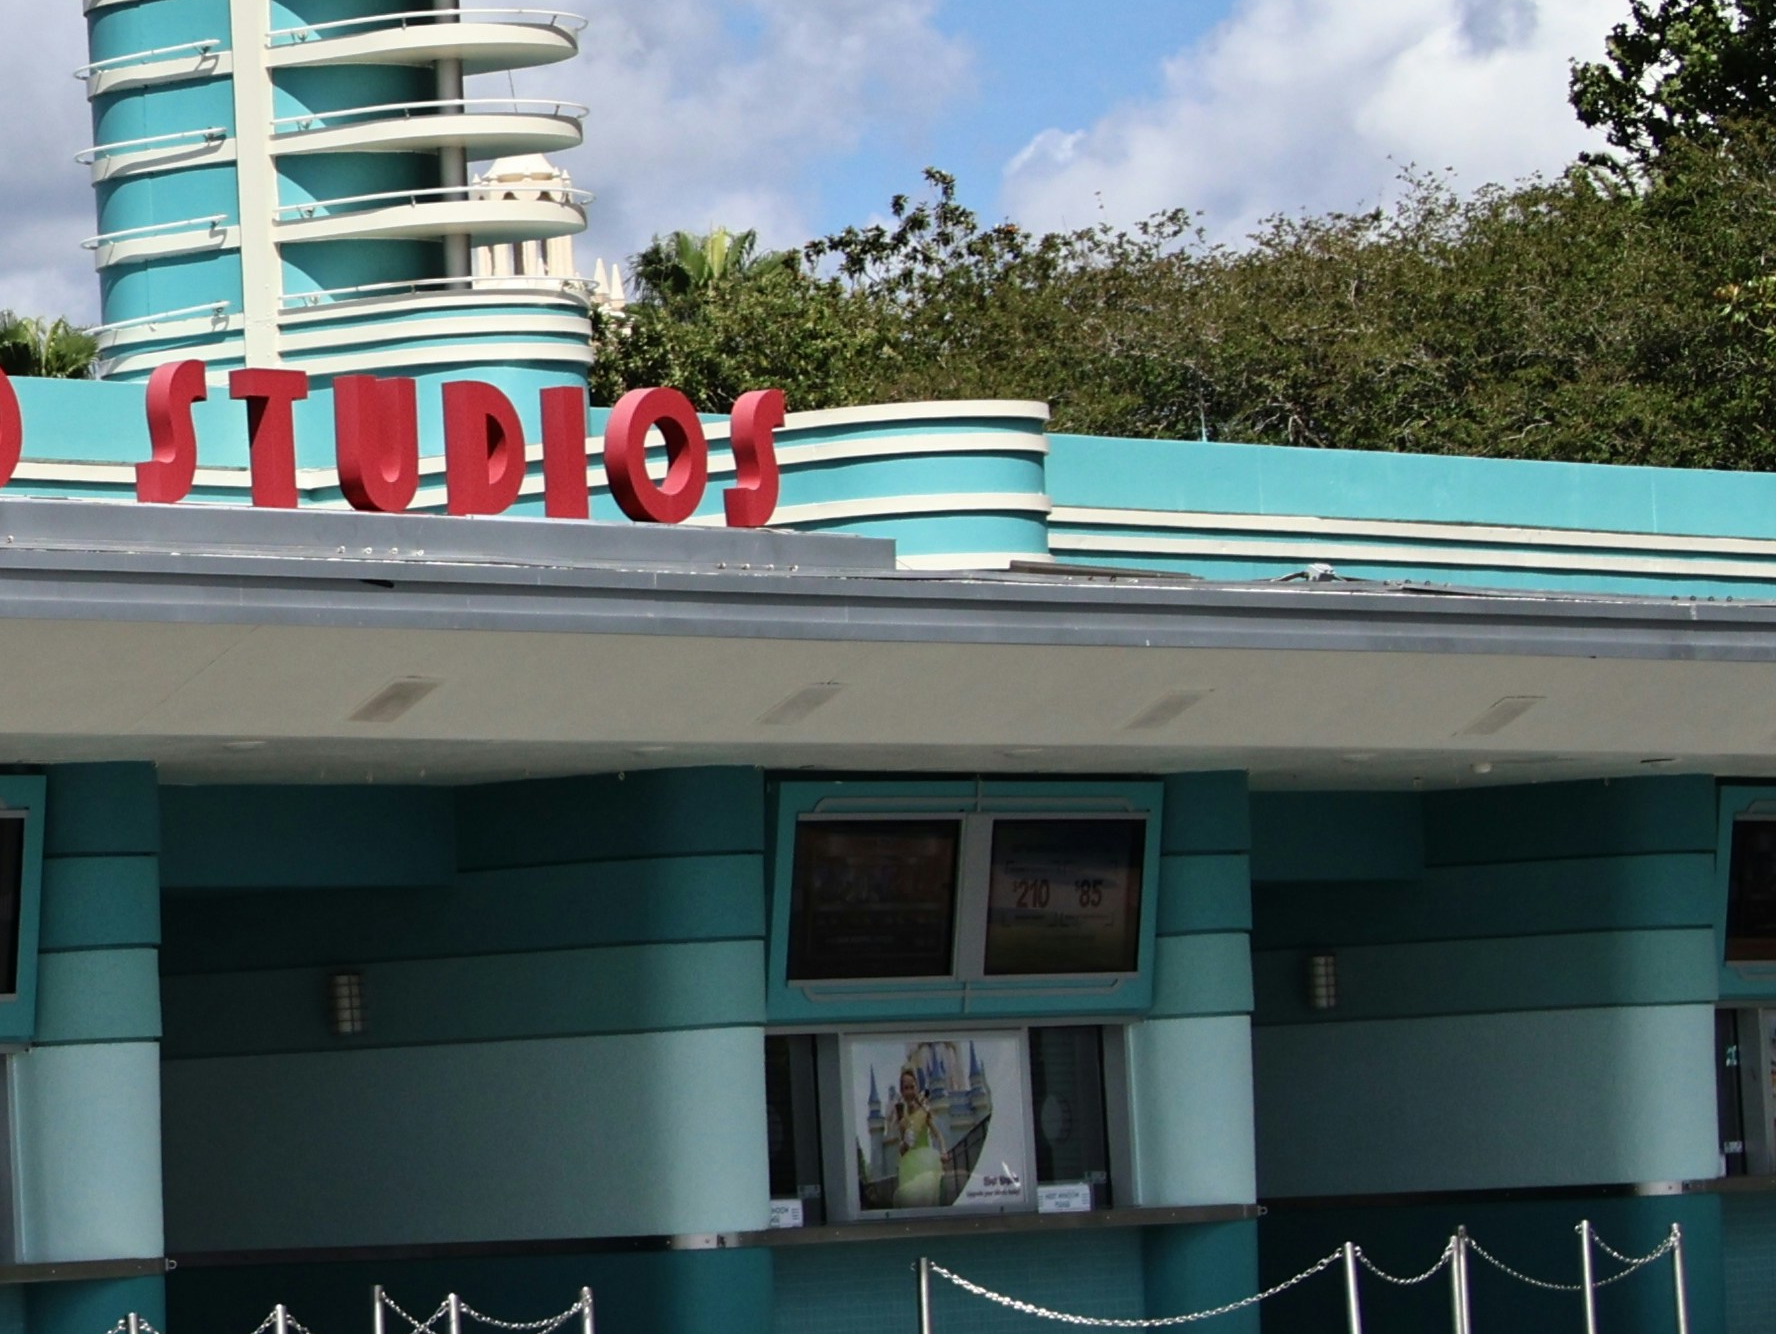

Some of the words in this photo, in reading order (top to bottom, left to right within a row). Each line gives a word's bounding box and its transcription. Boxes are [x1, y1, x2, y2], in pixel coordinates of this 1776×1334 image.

[135, 359, 787, 530] STUDIOS
[1013, 878, 1050, 909] $210
[1075, 878, 1104, 907] $85
